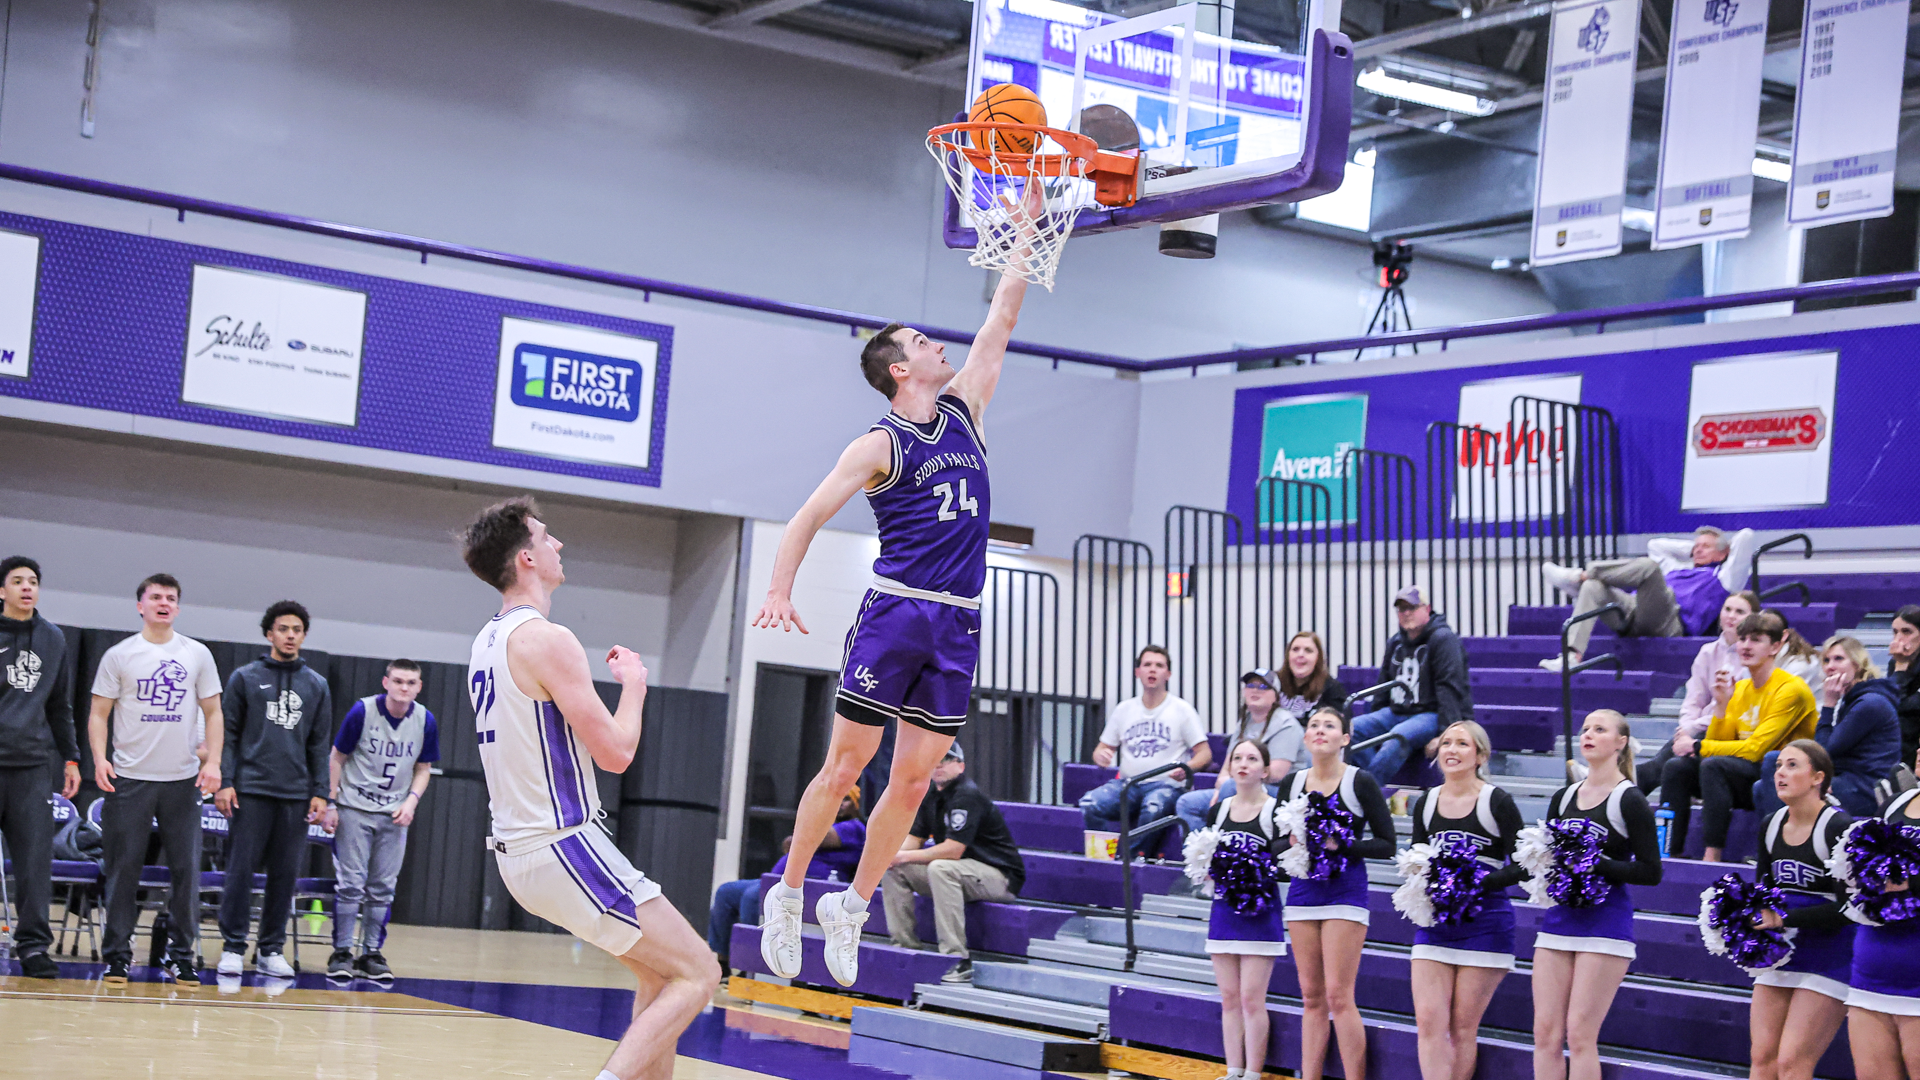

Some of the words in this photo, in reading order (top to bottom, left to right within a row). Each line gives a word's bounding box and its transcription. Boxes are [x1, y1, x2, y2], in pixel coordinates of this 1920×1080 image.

[1685, 181, 1731, 202] SOFTBALL
[1559, 202, 1603, 221] BASEBALL
[194, 315, 273, 357] Schulte
[551, 356, 634, 392] FIRST
[550, 381, 631, 411] DAKOTA
[531, 421, 615, 442] FirstDakota.com
[914, 454, 947, 487] SIOUX
[943, 452, 981, 471] FALLS
[1270, 447, 1332, 480] Avera
[932, 478, 979, 522] 24
[6, 664, 42, 693] USF
[854, 664, 879, 693] USF
[136, 679, 188, 711] USF
[471, 666, 496, 745] 22
[140, 713, 183, 723] COUGARS
[266, 701, 303, 730] USF
[1124, 721, 1171, 742] COUGARS
[368, 738, 415, 758] SIOUX
[377, 763, 397, 791] 5
